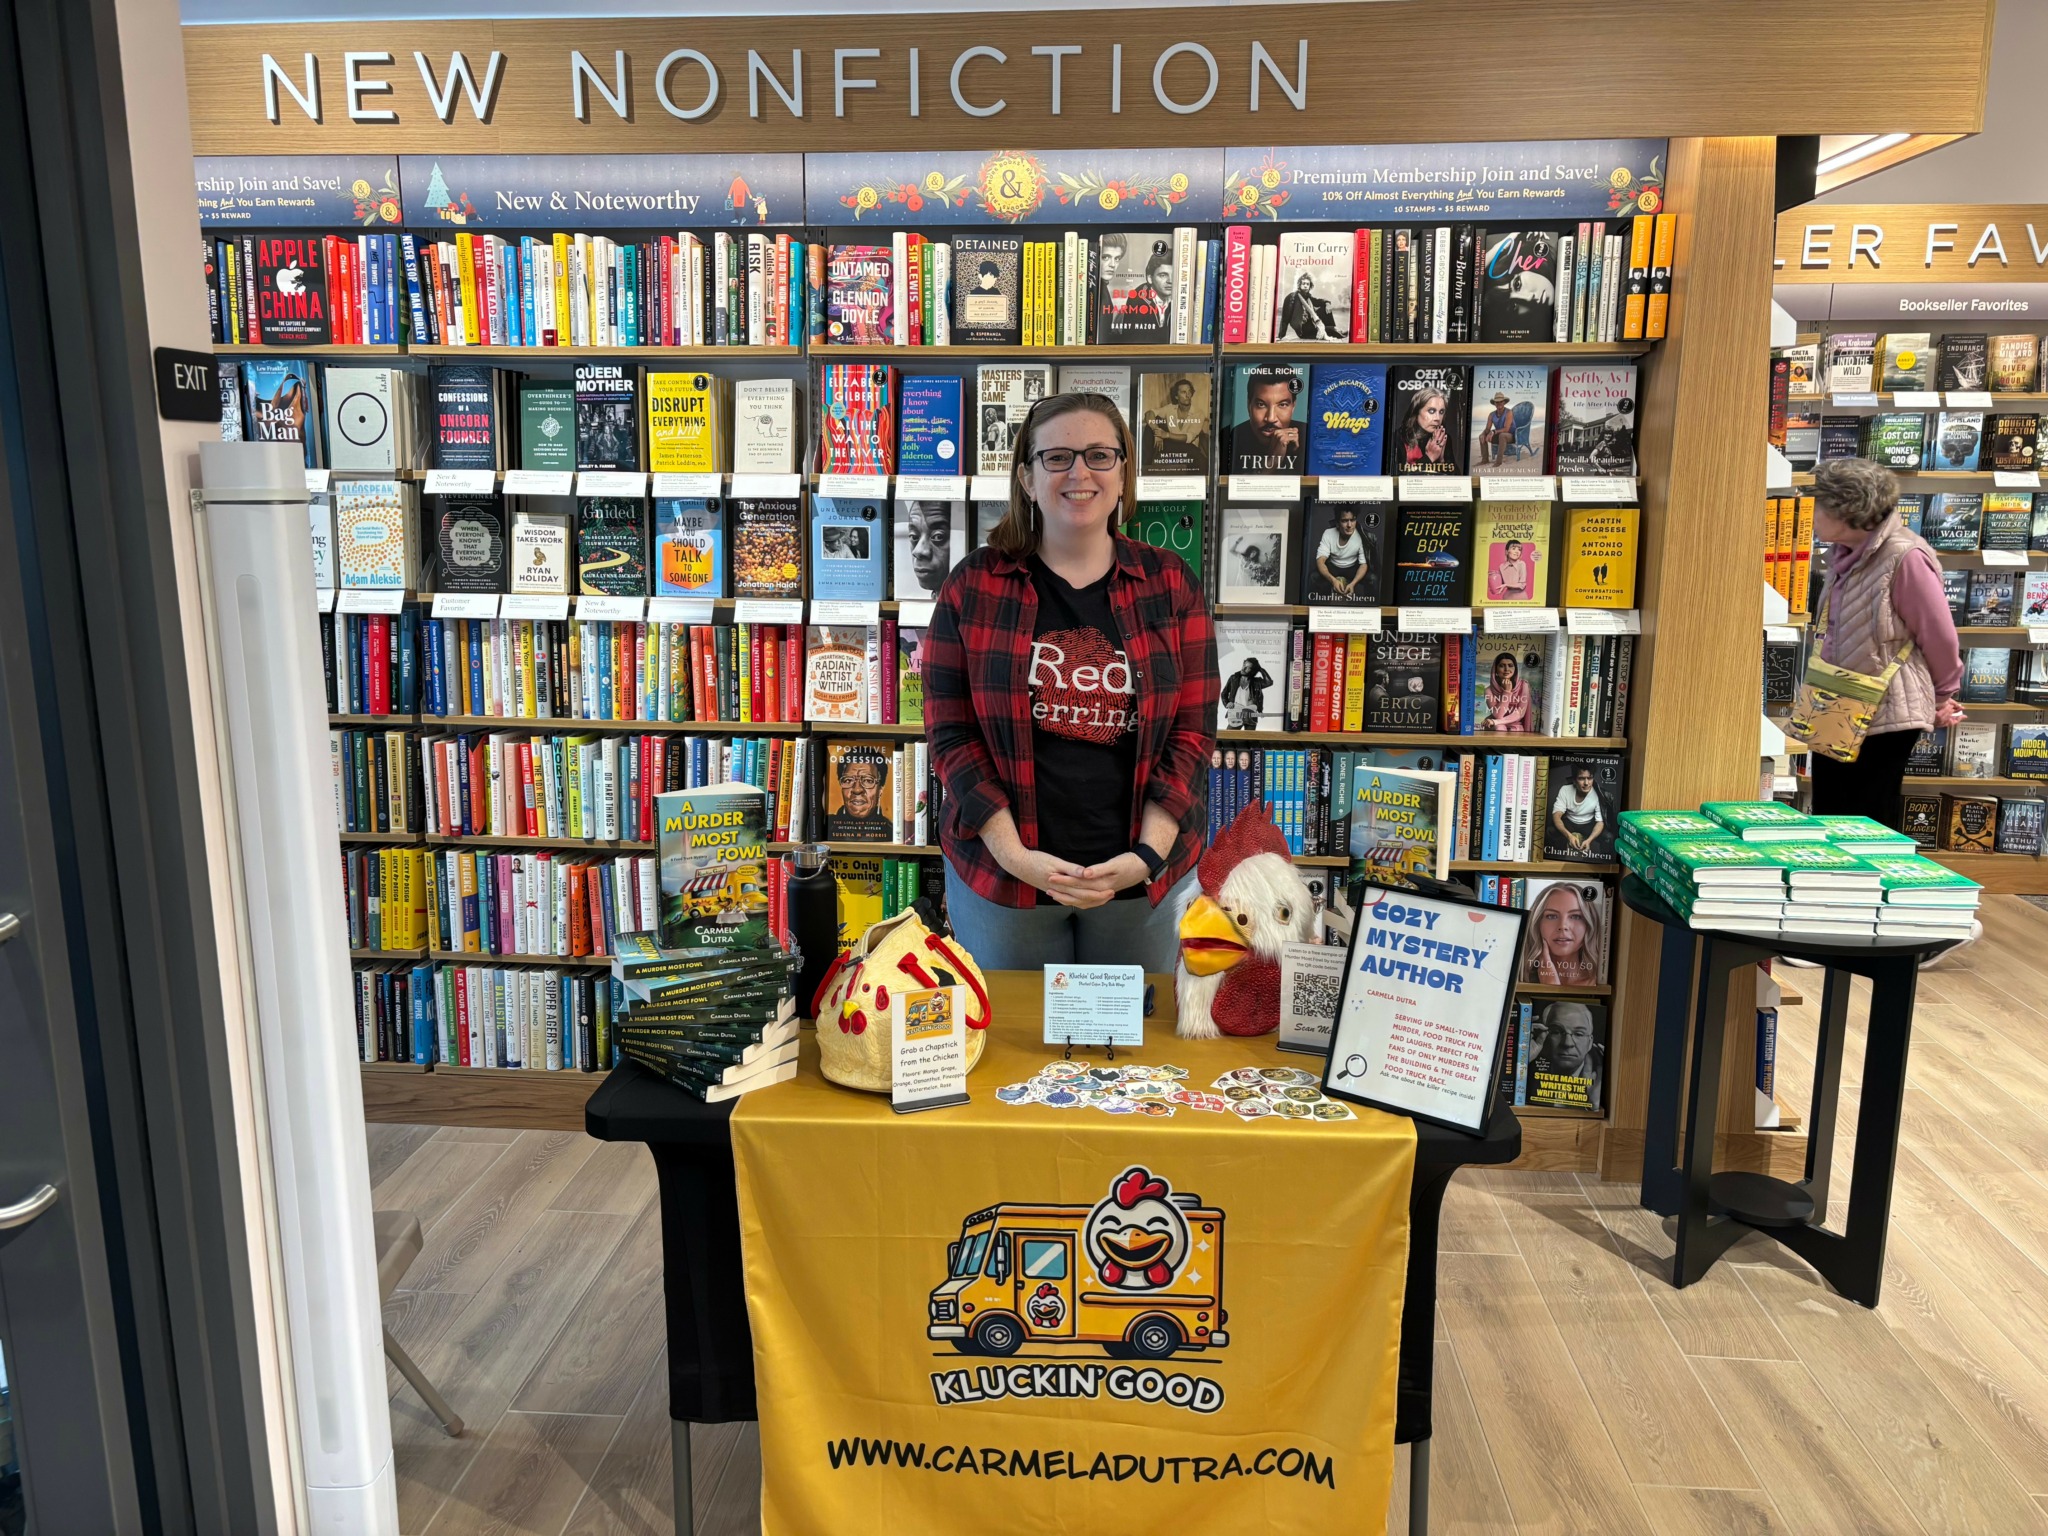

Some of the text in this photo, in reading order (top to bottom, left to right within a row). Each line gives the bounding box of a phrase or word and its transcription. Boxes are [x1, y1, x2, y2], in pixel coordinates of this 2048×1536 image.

[261, 39, 1309, 121] NEW NONFICTION
[1293, 164, 1599, 186] Premium Membership Join and Save!
[238, 176, 341, 194] Join and Save!
[1322, 187, 1566, 203] 10% Off Almost Everything And You Earn Rewards
[496, 190, 700, 217] New & Noteworthy
[955, 239, 1019, 251] DETAINED
[1293, 242, 1350, 257] Tim Curry
[1774, 223, 1885, 267] ER
[259, 239, 319, 268] APPLE
[748, 242, 762, 274] RISK
[1488, 237, 1548, 280] Cher
[1283, 254, 1335, 269] Vagabond
[832, 261, 889, 278] UNTAMED
[1230, 241, 1246, 313] ATWOOD
[261, 291, 324, 320] CHINA
[832, 290, 889, 307] GLENNON
[1899, 298, 2029, 312] Bookseller Favorites
[841, 308, 880, 325] DOYLE
[2000, 341, 2034, 351] CANDICE
[1836, 355, 1871, 366] INTO THE
[1999, 349, 2034, 358] MILLARD
[173, 362, 209, 392] EXIT
[575, 366, 622, 379] QUEEN
[981, 369, 1022, 381] MASTERS
[1242, 367, 1304, 376] LIONEL RICHIE
[1487, 369, 1535, 380] KENNY
[1842, 366, 1862, 376] WILD
[575, 379, 634, 392] MOTHER
[981, 380, 1011, 392] OF THE
[1478, 379, 1544, 390] CHESNEY
[438, 392, 488, 403] CONFESSIONS
[834, 391, 880, 402] GILBERT
[981, 392, 1006, 403] GAME
[652, 396, 705, 413] DISRUPT
[260, 402, 295, 426] Bag
[439, 413, 490, 428] UNICORN
[652, 416, 706, 428] EVERYTHING
[1322, 410, 1371, 435] Wings
[258, 421, 300, 441] Man
[440, 430, 490, 444] FOUNDER
[1239, 454, 1298, 470] TRULY
[583, 503, 636, 519] Guided
[737, 501, 797, 511] The Anxious
[673, 517, 703, 528] MAYBE
[738, 511, 796, 523] Generation
[1586, 517, 1622, 525] MARTIN
[523, 529, 556, 537] WISDOM
[682, 528, 696, 537] YOU
[1403, 521, 1462, 537] FUTURE
[516, 536, 538, 544] TAKES
[672, 538, 706, 549] SHOULD
[1416, 538, 1449, 553] BOY
[1581, 541, 1624, 549] ANTONIO
[674, 550, 703, 563] TALK
[526, 567, 551, 575] RYAN
[684, 563, 693, 572] TO
[344, 573, 402, 586] Adam Aleksic
[519, 574, 560, 583] HOLIDAY
[669, 572, 709, 583] SOMEONE
[1404, 570, 1456, 583] MICHAEL
[737, 580, 798, 590] Jonathan Haidt
[1411, 584, 1447, 597] J. FOX
[1371, 630, 1439, 643] UNDER
[1376, 646, 1432, 661] SIEGE
[1478, 642, 1541, 652] YOUSAFZAI
[815, 660, 858, 672] RADIANT
[1027, 640, 1137, 695] Red
[1314, 649, 1329, 696] BOWIE
[819, 671, 852, 681] ARTIST
[818, 681, 854, 692] WITHIN
[1331, 646, 1345, 722] supersonic
[1379, 697, 1422, 710] ERIC
[1029, 698, 1140, 733] erring
[1370, 711, 1432, 724] TRUMP
[836, 745, 887, 755] POSITIVE
[829, 754, 893, 765] OBSESSION
[1371, 775, 1381, 788] A
[1356, 787, 1421, 809] MURDER
[681, 801, 694, 813] A
[664, 811, 745, 832] MURDER
[1376, 806, 1416, 824] MOST
[690, 830, 739, 847] MOST
[1394, 825, 1436, 844] FOWL
[716, 845, 765, 862] FOWL
[1543, 845, 1612, 861] Charlie Sheen
[1371, 901, 1441, 931] COZY
[1365, 927, 1490, 970] MYSTERY
[642, 964, 668, 974] MURDER
[669, 962, 686, 971] MOST
[686, 961, 704, 969] FOWL
[1527, 958, 1594, 971] TOLD YOU SO
[1069, 971, 1136, 982] Kluckin' Good Recipe Card
[1359, 953, 1465, 994] AUTHOR
[1366, 988, 1417, 1007] CARMELA DUTRA
[1394, 1012, 1480, 1040] SERVING UP SMALL-TOWN
[1392, 1023, 1484, 1052] MURDER, FOOD TRUCK FUN,
[900, 1040, 959, 1055] Grab Chapstick
[1390, 1033, 1405, 1042] AND
[1436, 1045, 1463, 1057] PERFECT
[1464, 1052, 1479, 1061] FOR
[899, 1051, 959, 1067] from the Chicken
[1534, 1071, 1594, 1086] STEVE MARTIN
[1539, 1080, 1587, 1094] WRITES THE
[1536, 1088, 1589, 1102] WRITTEN WORD
[931, 1363, 1223, 1413] KLUCKIN' GOOD
[826, 1436, 1336, 1490] WWW.CARMELADUTRA.COM
